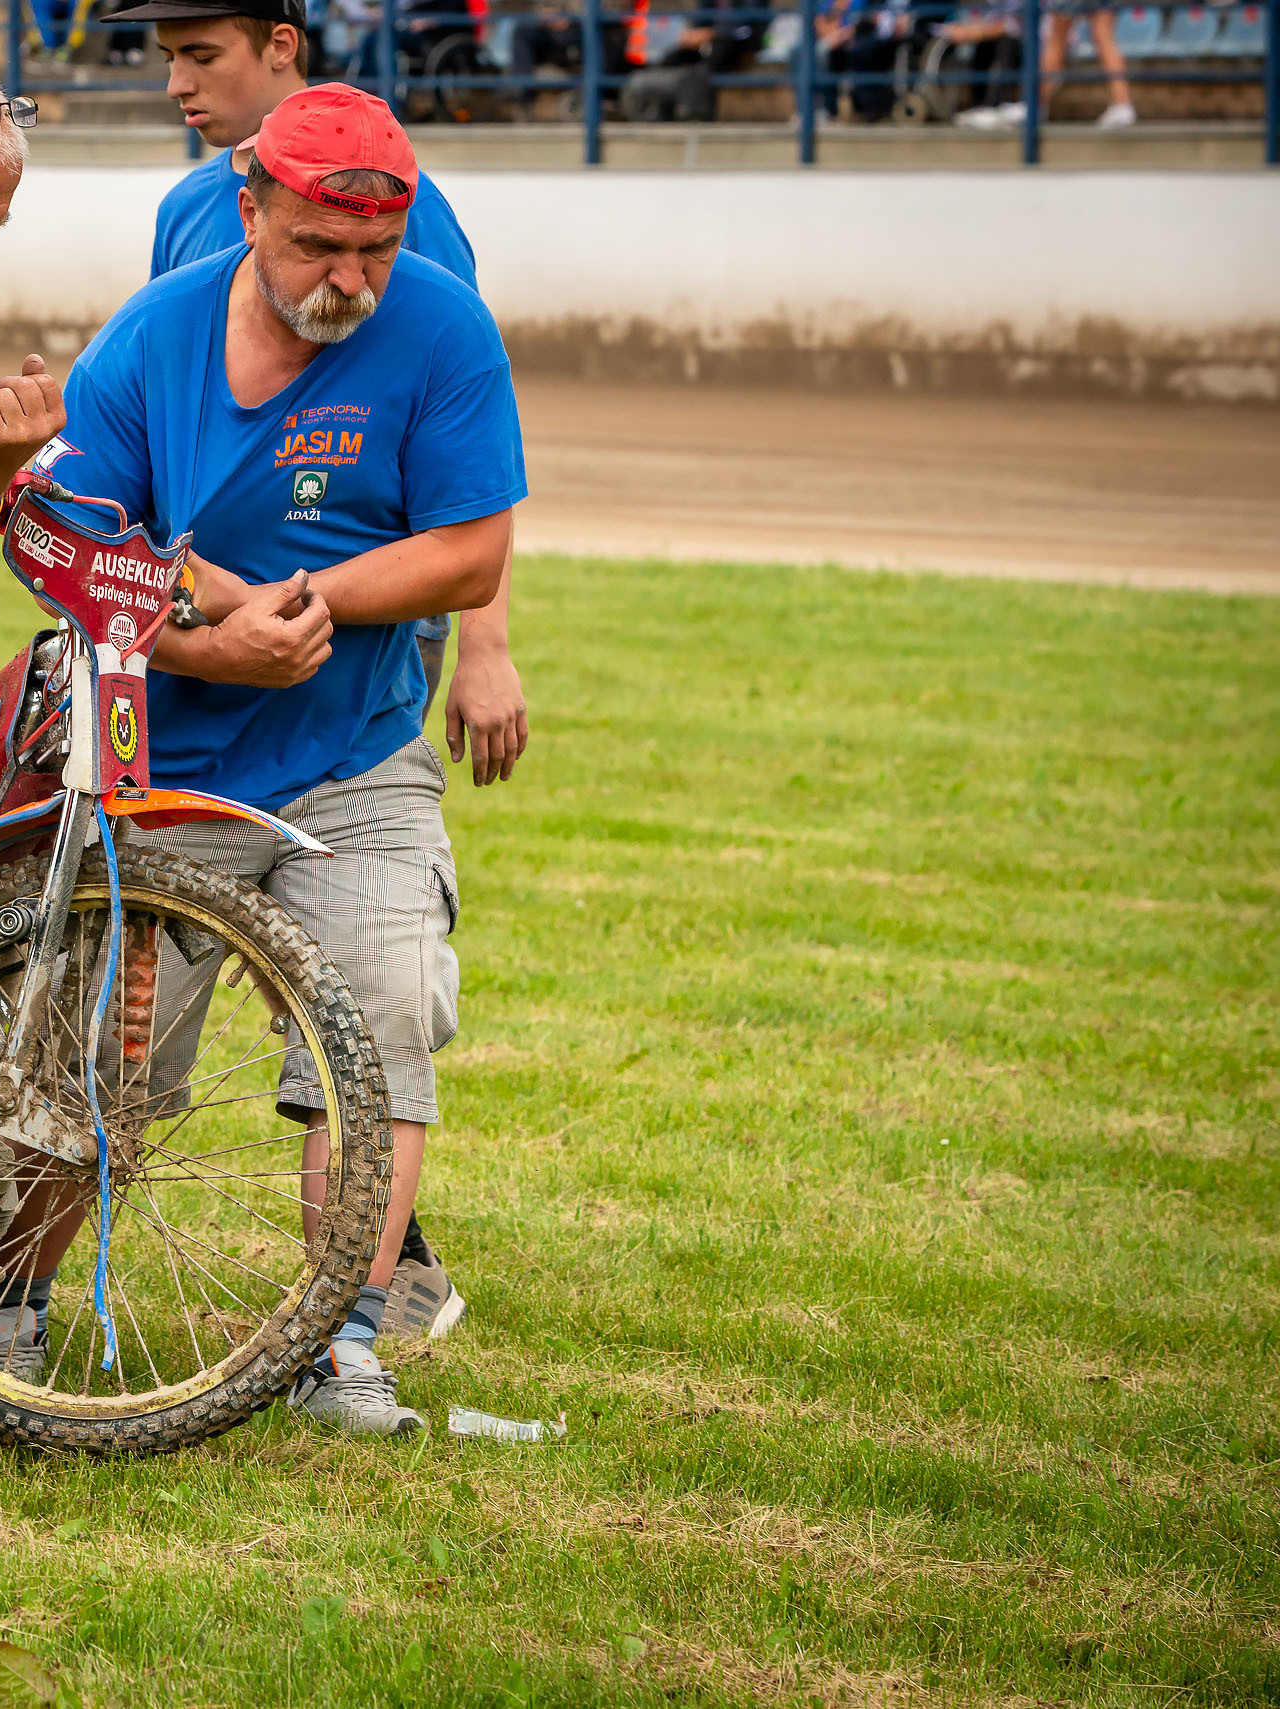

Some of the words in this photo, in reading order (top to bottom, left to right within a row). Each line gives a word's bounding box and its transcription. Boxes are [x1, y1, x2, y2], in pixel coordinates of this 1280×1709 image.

[300, 416, 330, 425] NORTH
[334, 415, 368, 423] EUROPE
[301, 404, 371, 419] TECNOPALI
[275, 430, 333, 458] JASI
[338, 431, 363, 454] M
[91, 551, 165, 589] AUSEKLIS
[89, 583, 133, 608] spīdveja
[135, 591, 160, 613] klubs
[114, 618, 131, 635] JAWA
